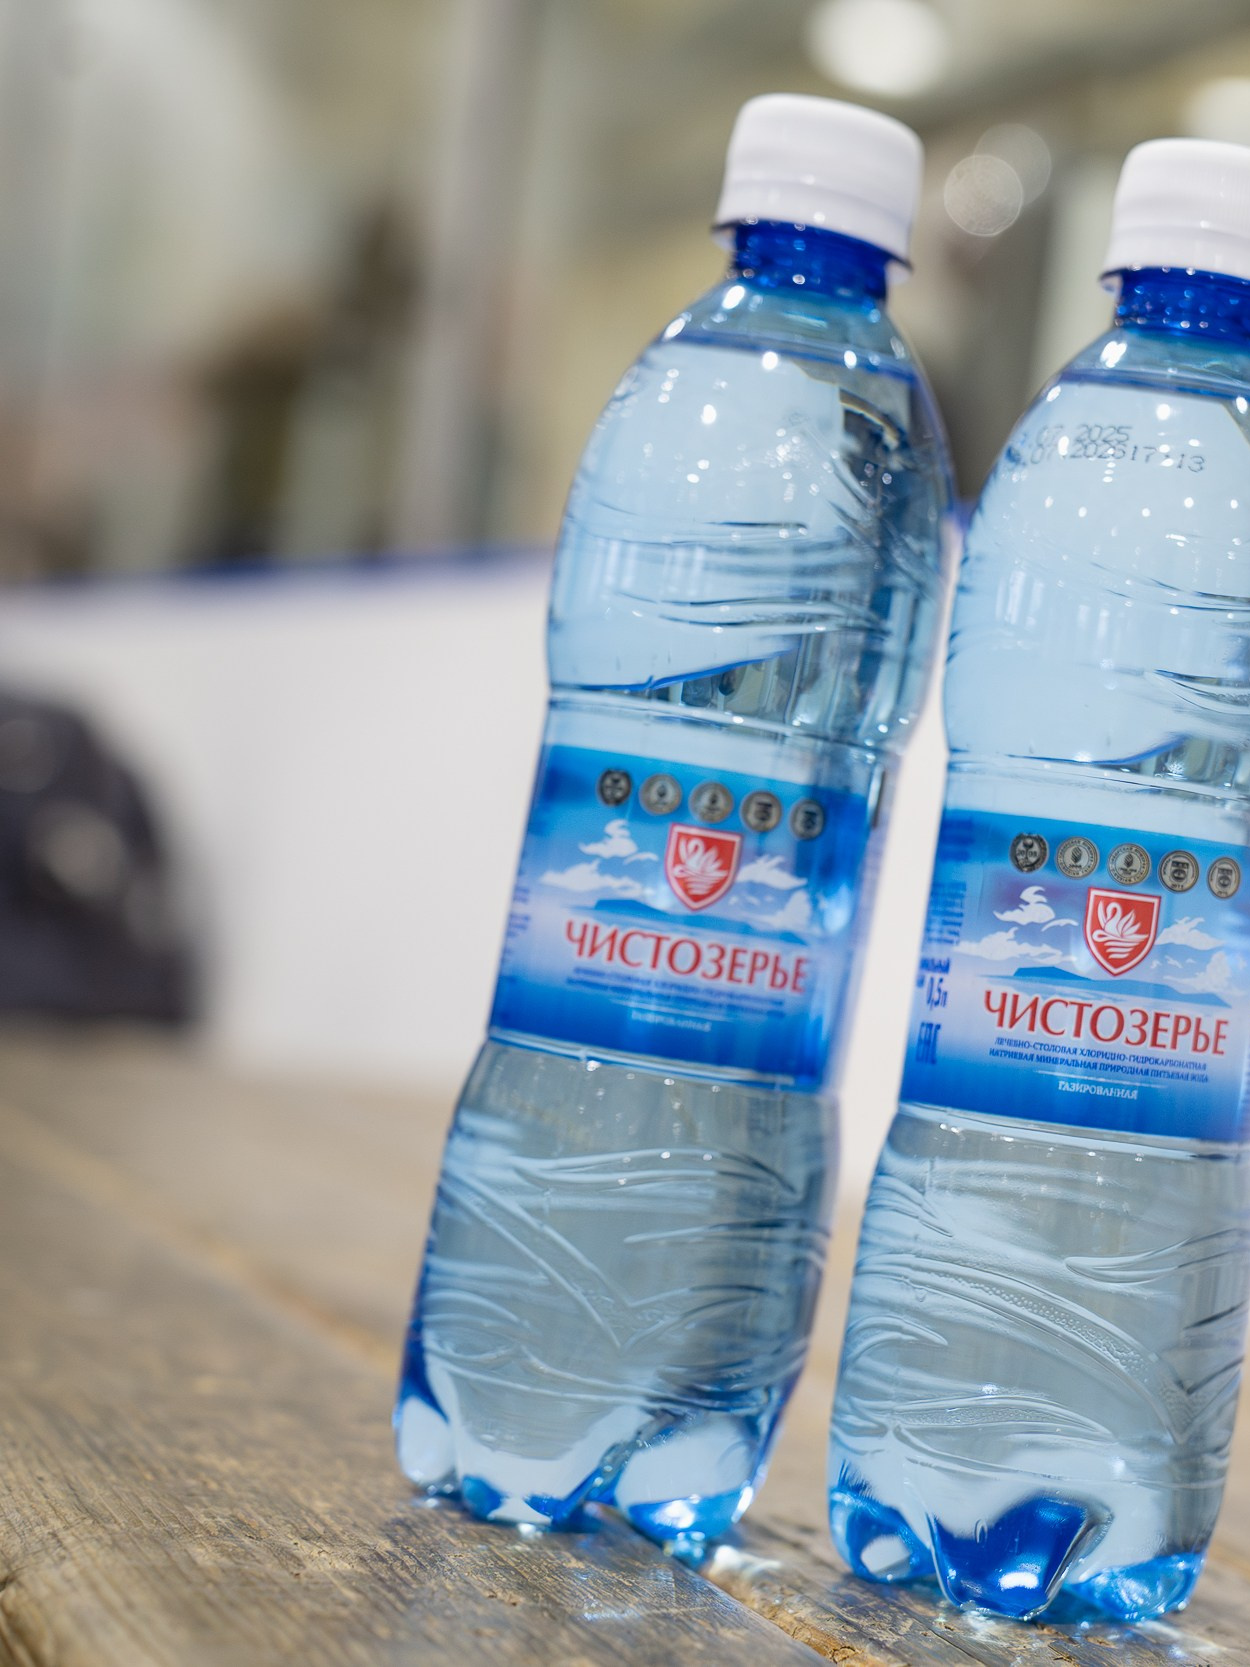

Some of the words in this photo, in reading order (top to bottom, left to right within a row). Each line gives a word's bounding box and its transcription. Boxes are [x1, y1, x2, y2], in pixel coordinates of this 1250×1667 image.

[565, 920, 812, 995] ЧИСТОЗЕРЬЕ
[983, 991, 1229, 1056] ЧИСТОЗЕРЬЕ
[989, 1048, 1035, 1062] НАТРИЕВАЯ
[1035, 1054, 1097, 1070] МИНЕРАЛЬНАЯ
[1099, 1062, 1149, 1076] ПРИРОДНАЯ
[995, 1037, 1078, 1055] ЛЕЧЕБНО-СТОЛОВАЯ
[1079, 1048, 1207, 1071] ХЛОРИДНО-ГИДРОКАРБОНАТНАЯ
[1058, 1080, 1138, 1100] ГАЗИРОВАННАЯ
